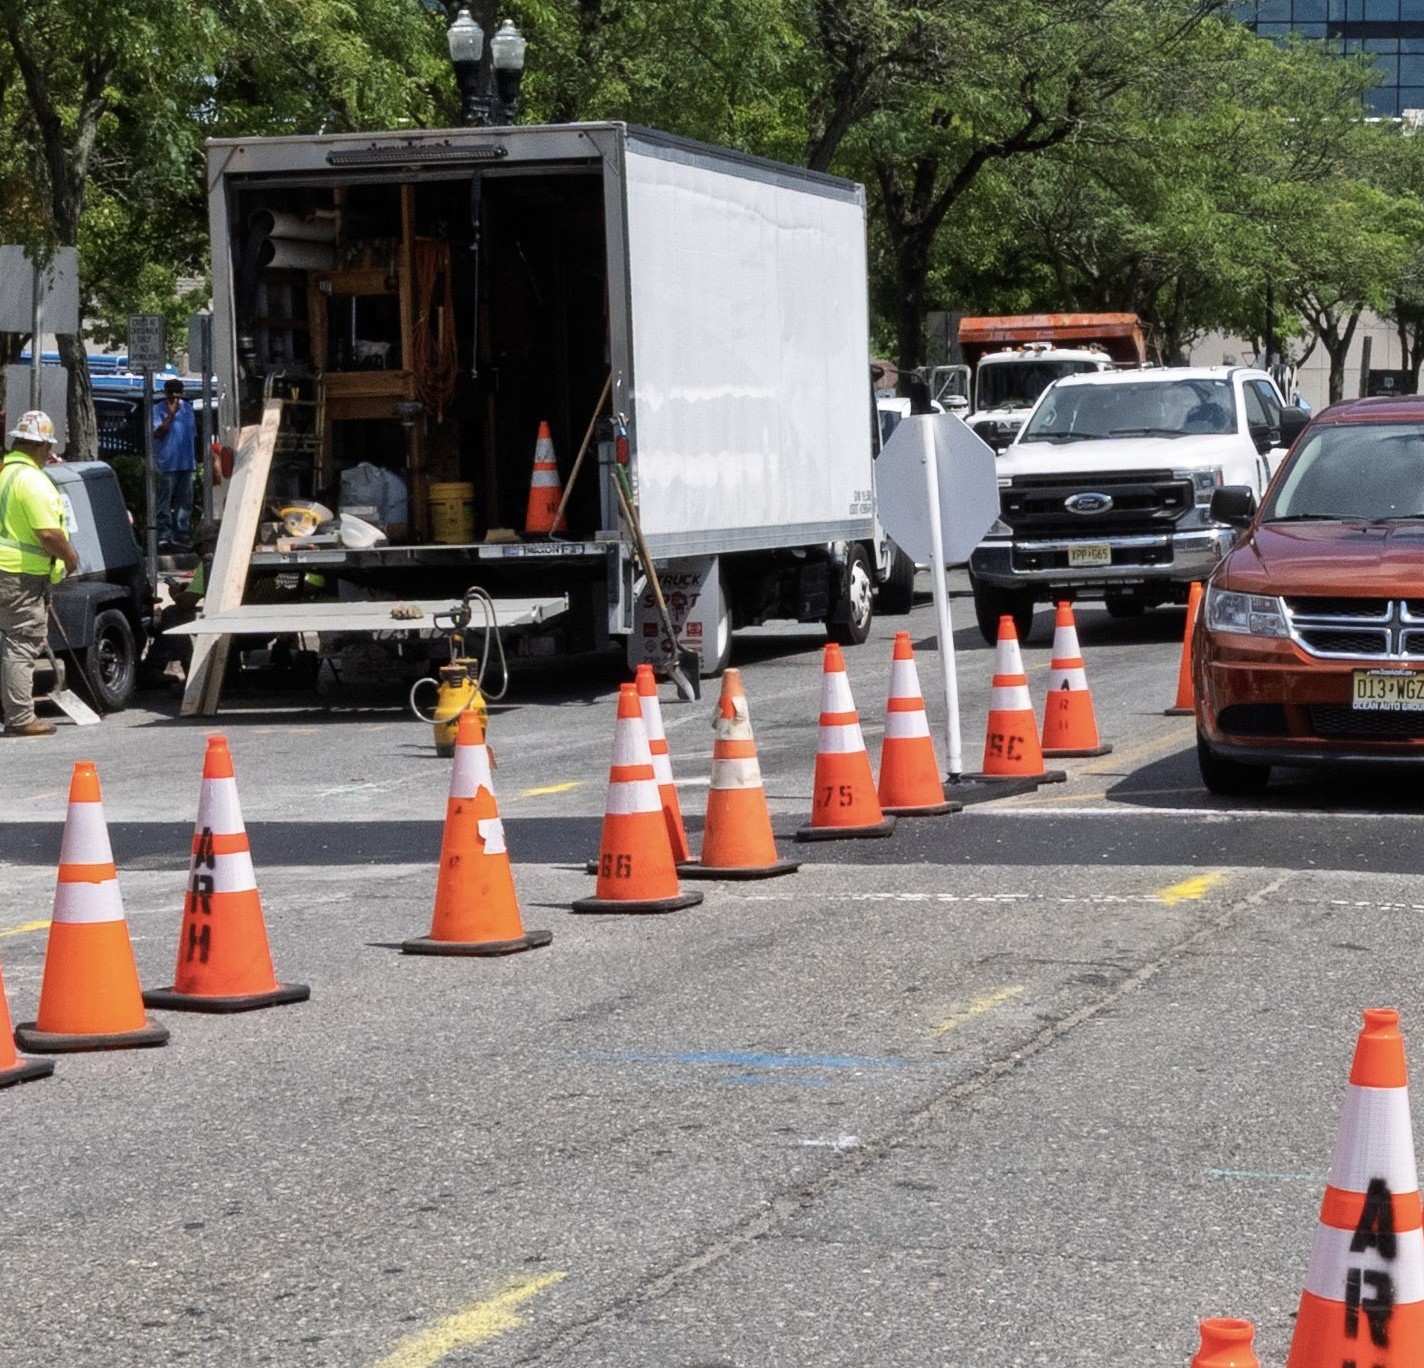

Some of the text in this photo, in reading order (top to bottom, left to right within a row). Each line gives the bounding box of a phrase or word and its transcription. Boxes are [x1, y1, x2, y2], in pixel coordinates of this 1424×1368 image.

[1077, 498, 1099, 510] Ford
[1357, 679, 1424, 699] D13 WGZ
[1353, 702, 1377, 710] OCEAN
[1380, 702, 1400, 711] AUTO
[822, 785, 853, 807] 75
[186, 826, 215, 965] ARH
